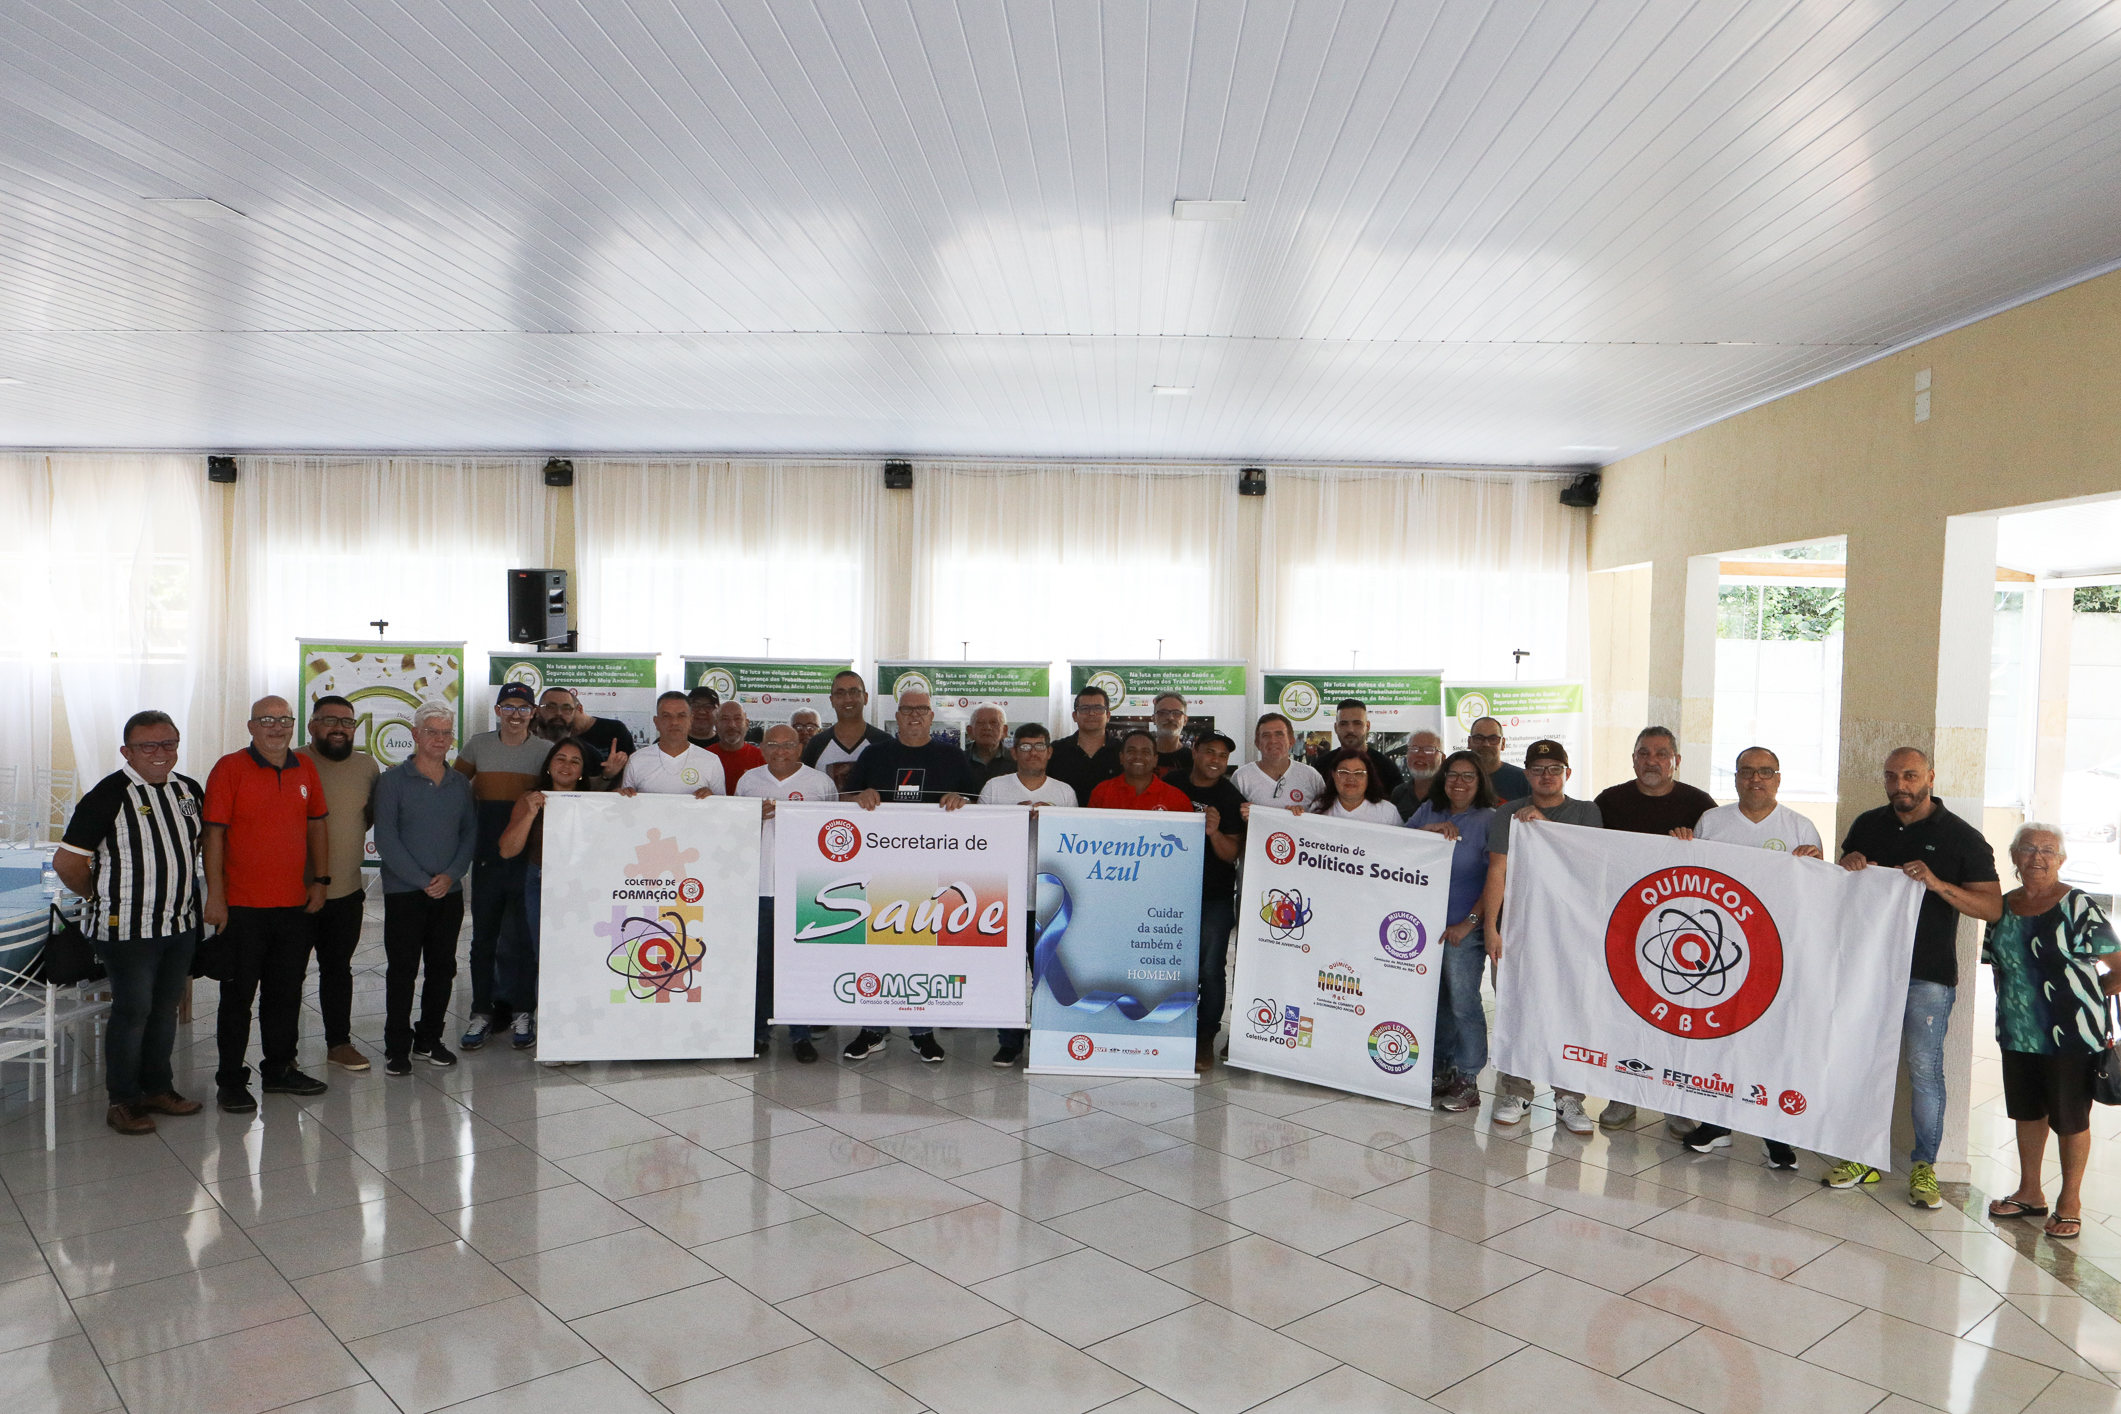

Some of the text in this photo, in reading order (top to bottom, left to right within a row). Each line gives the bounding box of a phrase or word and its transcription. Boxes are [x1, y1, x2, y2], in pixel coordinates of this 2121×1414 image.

[1286, 690, 1312, 706] 40
[1462, 701, 1483, 718] 40
[386, 738, 412, 748] Anos
[866, 833, 987, 850] Secretaria de
[1057, 833, 1173, 857] Novembro
[1299, 838, 1366, 857] Secretaria de
[1086, 860, 1140, 881] Azul
[1298, 851, 1429, 886] Políticas Sociais
[612, 888, 677, 902] FORMAÇÃO
[1640, 870, 1754, 921] QUÍMICOS
[794, 873, 1004, 941] Saúde
[1147, 908, 1184, 918] Cuidar
[1388, 913, 1420, 926] MULHERES
[1138, 923, 1183, 934] da saúde
[1131, 939, 1182, 949] também é
[1140, 955, 1181, 965] coisa de
[1127, 970, 1181, 981] HOMEM!
[1318, 970, 1362, 996] RACIAL
[834, 972, 966, 1004] COMSAT
[1246, 1033, 1285, 1045] Coletivo PCD
[1564, 1047, 1602, 1065] CUT
[1663, 1068, 1734, 1094] FETQUIM
